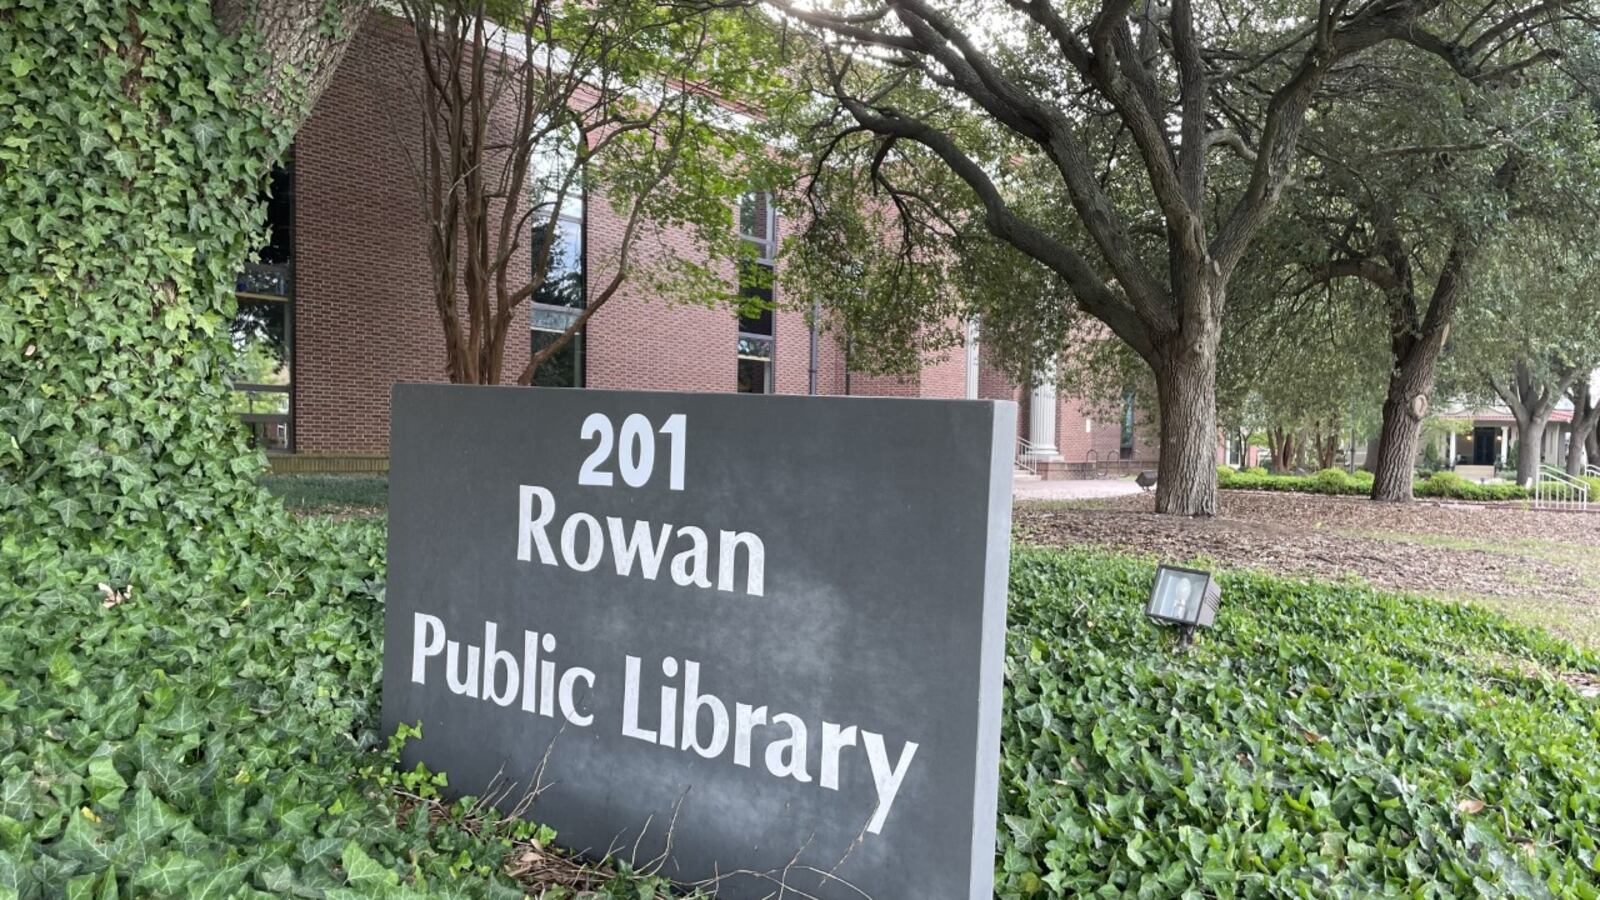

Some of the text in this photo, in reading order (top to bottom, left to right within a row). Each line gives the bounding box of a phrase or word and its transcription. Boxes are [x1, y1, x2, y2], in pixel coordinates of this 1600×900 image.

[578, 413, 688, 491] 201
[517, 484, 766, 597] Rowan
[411, 612, 920, 835] Public Library
